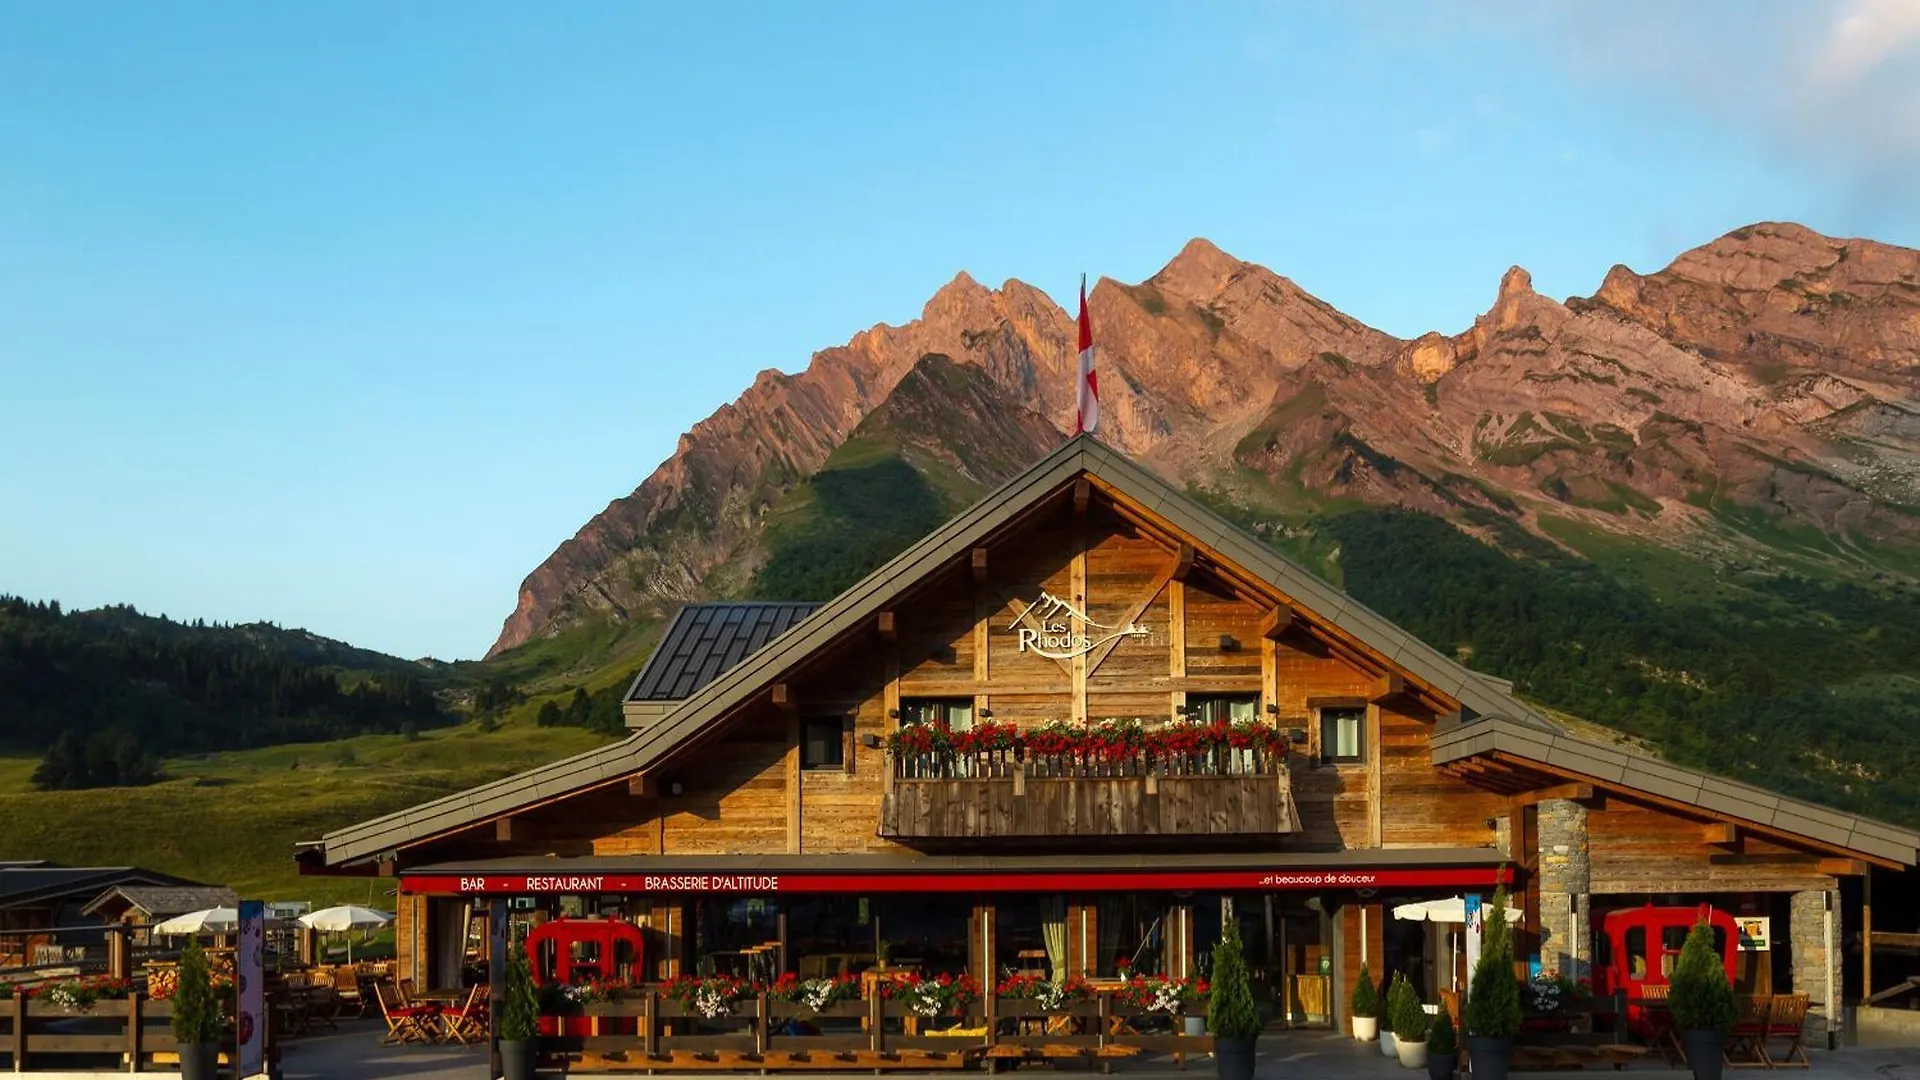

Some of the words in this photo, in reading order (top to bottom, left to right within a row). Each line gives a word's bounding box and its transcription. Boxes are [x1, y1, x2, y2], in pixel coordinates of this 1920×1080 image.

[1042, 620, 1067, 633] Les
[1018, 628, 1092, 652] Rhodos
[460, 877, 485, 891] BAR
[526, 876, 604, 890] RESTAURANT
[644, 876, 709, 890] BRASSERIE
[712, 876, 778, 890] D'ALTITUDE
[1275, 874, 1322, 885] beaucoup
[1324, 873, 1337, 884] de
[1338, 874, 1376, 884] douceur
